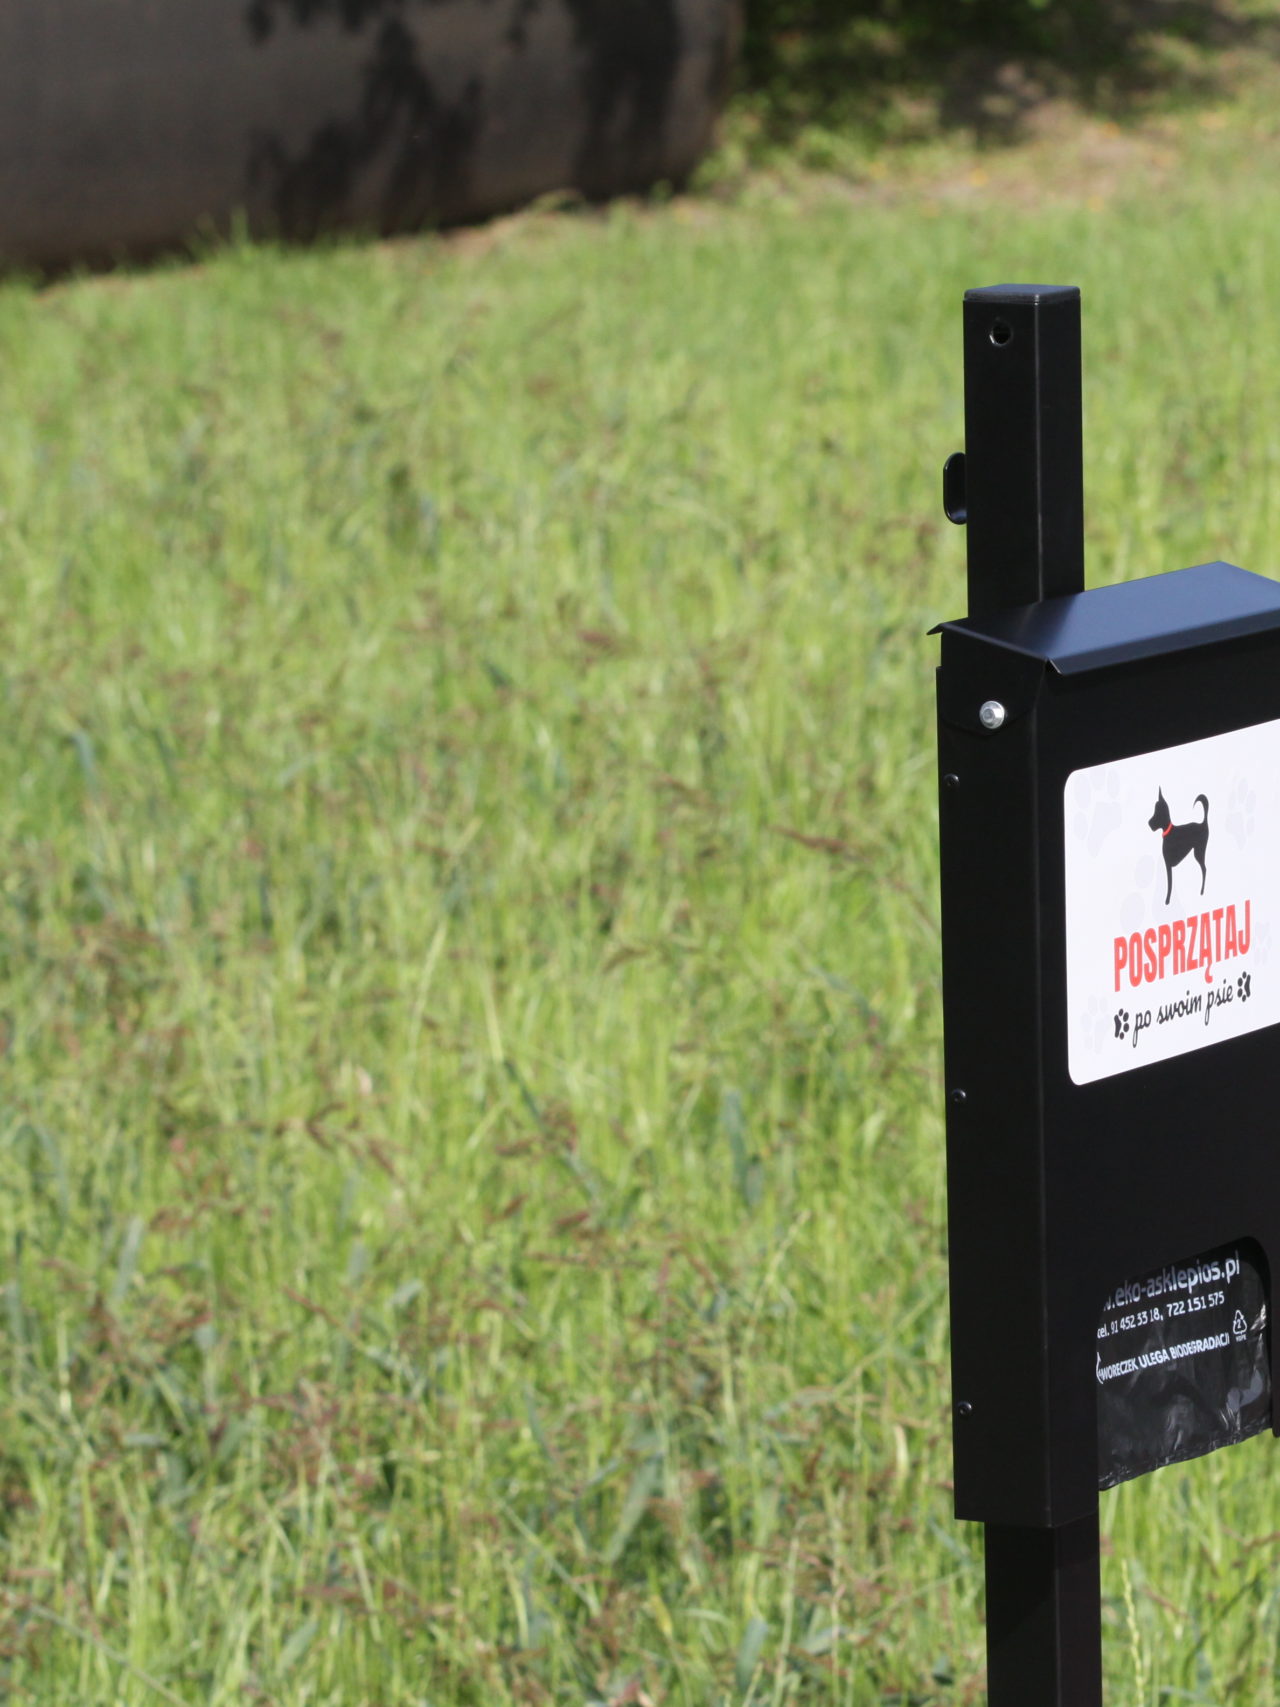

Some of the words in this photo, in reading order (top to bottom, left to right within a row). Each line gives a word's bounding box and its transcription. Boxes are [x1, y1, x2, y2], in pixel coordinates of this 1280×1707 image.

[1114, 899, 1250, 992] POSPRZĄTAJ
[1132, 1010, 1151, 1048] po
[1156, 990, 1202, 1024] swoim
[1204, 979, 1234, 1026] psie
[1111, 1320, 1118, 1335] 91
[1120, 1315, 1136, 1331] 452
[1137, 1311, 1148, 1326] 33
[1166, 1301, 1186, 1317] 722
[1187, 1296, 1207, 1312] 151
[1208, 1291, 1225, 1308] 575
[1138, 1348, 1171, 1369] ULEGA
[1169, 1332, 1230, 1360] BIODEGRADACJI
